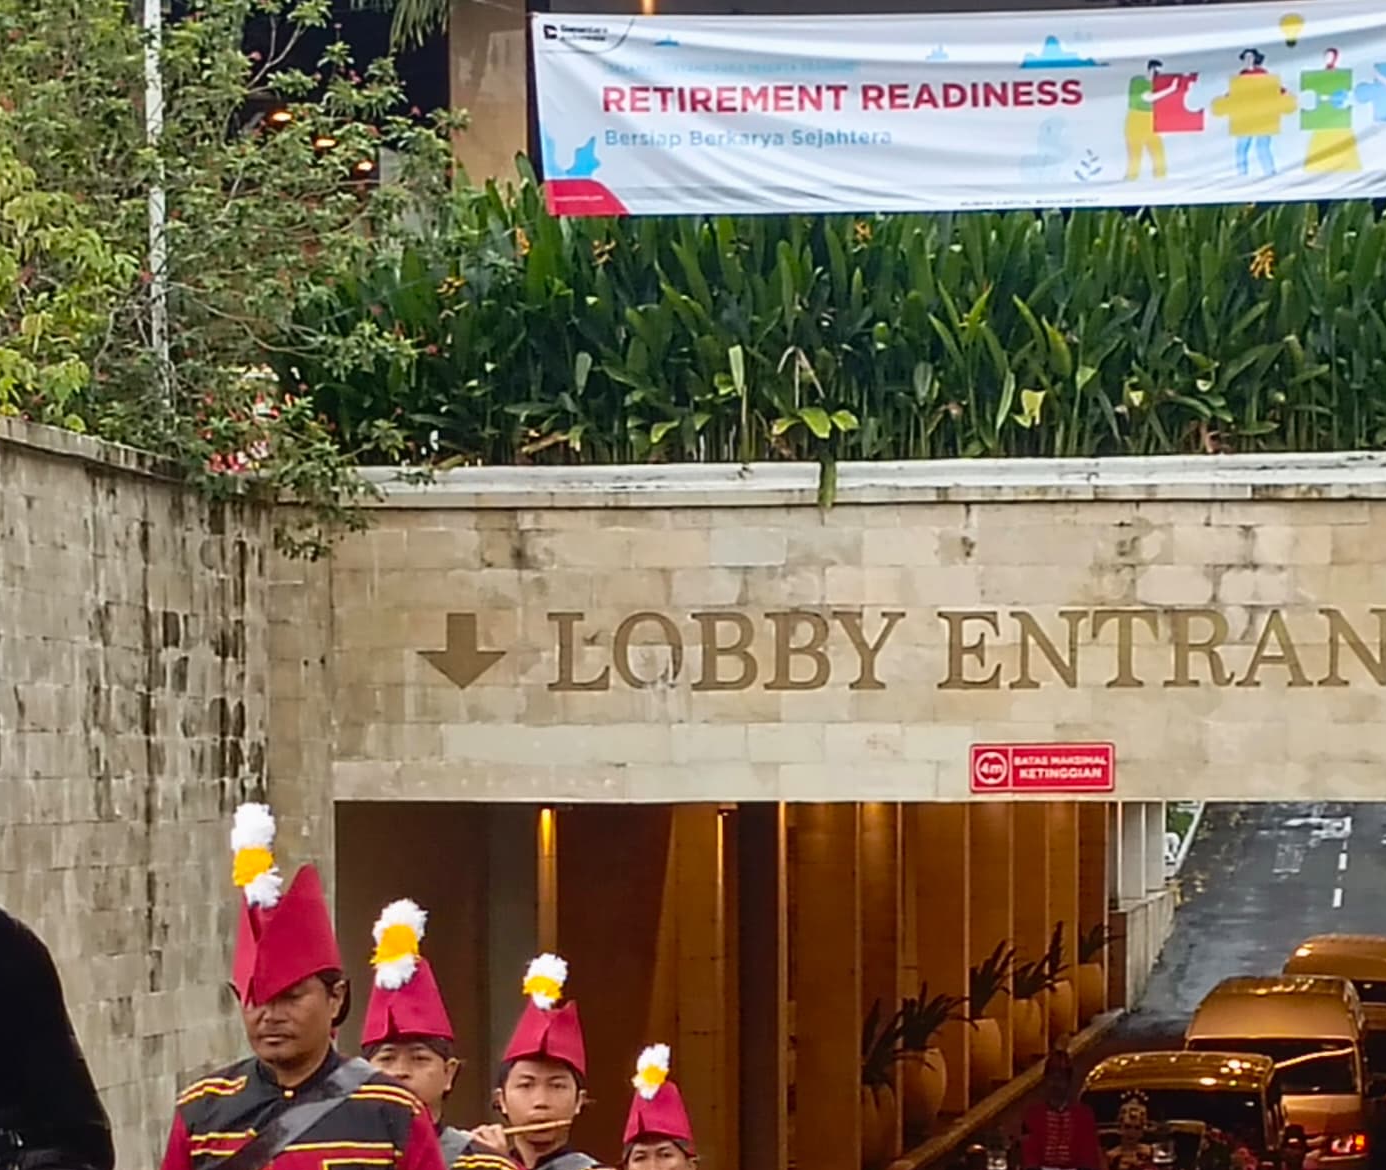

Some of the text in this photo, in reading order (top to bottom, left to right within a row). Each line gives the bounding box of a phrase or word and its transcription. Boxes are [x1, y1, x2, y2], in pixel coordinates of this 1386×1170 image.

[603, 80, 1083, 112] RETIREMENT READINESS
[605, 128, 892, 149] Bersiap Berkarya Sejahtera
[547, 611, 906, 692] LOBBY
[980, 762, 1004, 775] 4m
[1019, 767, 1102, 780] KETINGGIAN
